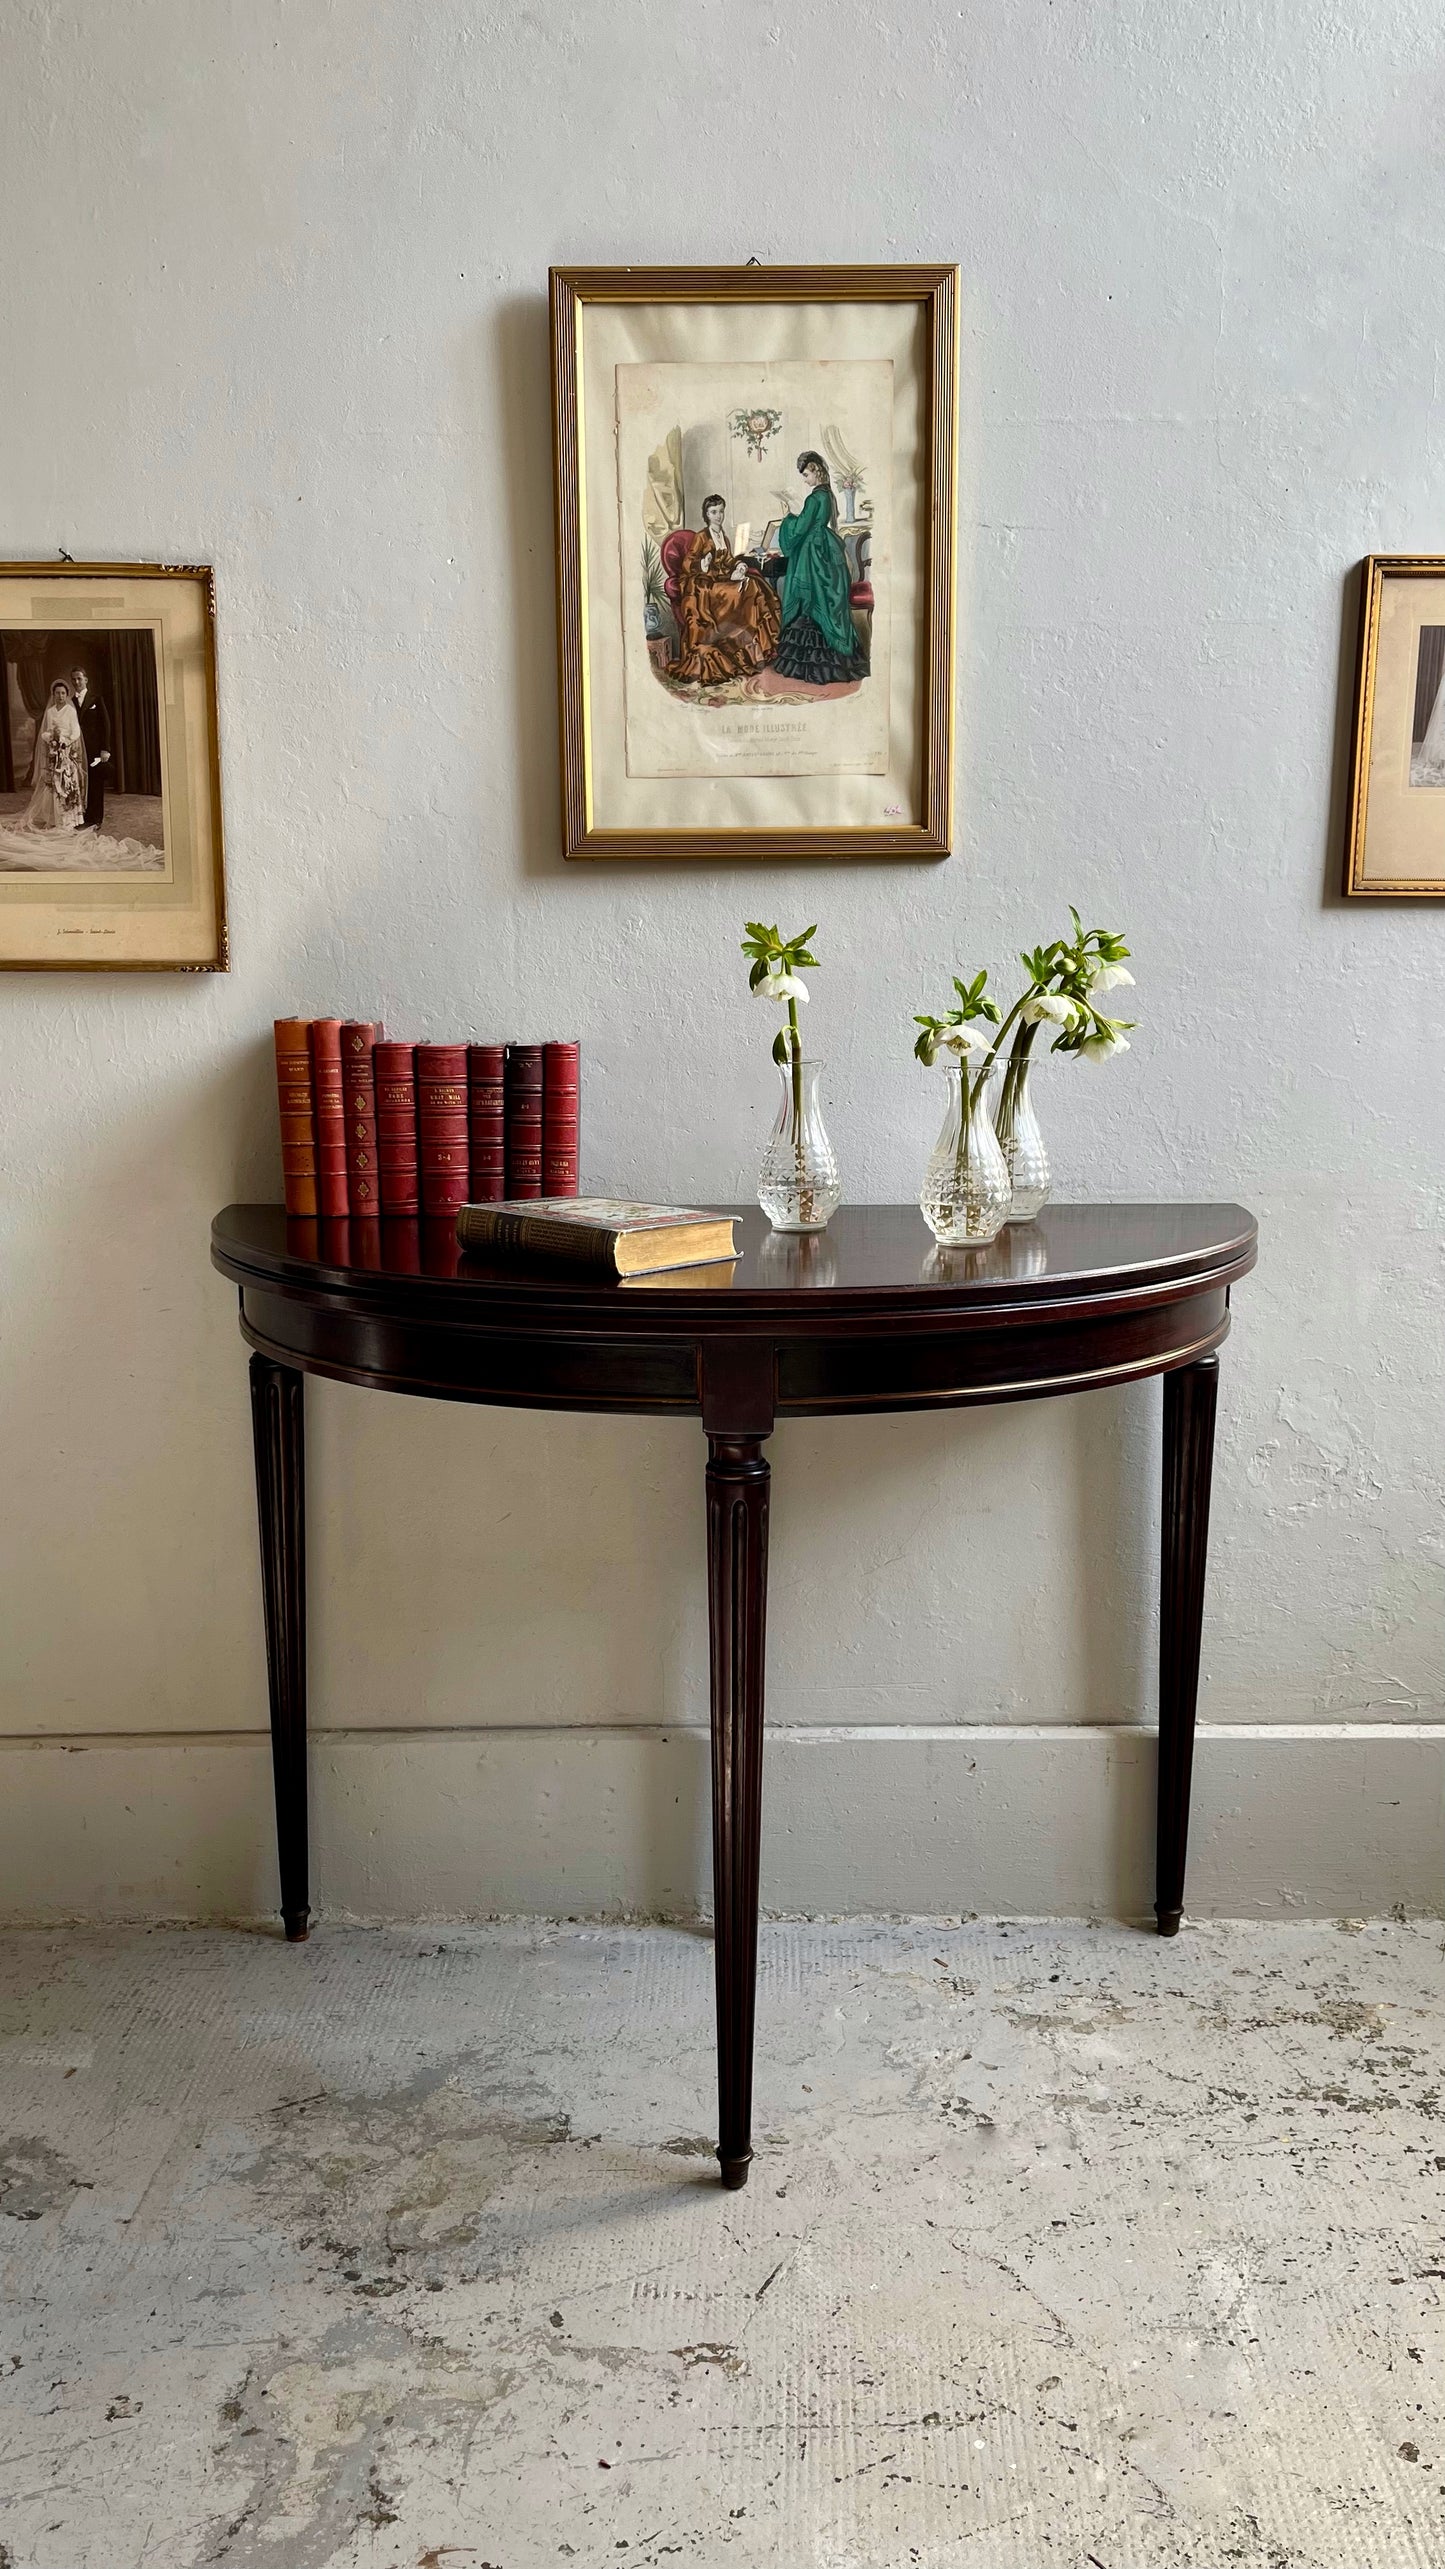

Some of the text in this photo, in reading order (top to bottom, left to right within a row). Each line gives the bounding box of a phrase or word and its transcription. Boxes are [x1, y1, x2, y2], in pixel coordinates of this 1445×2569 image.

[721, 721, 807, 734] LA MODE ILLUSTRÉE
